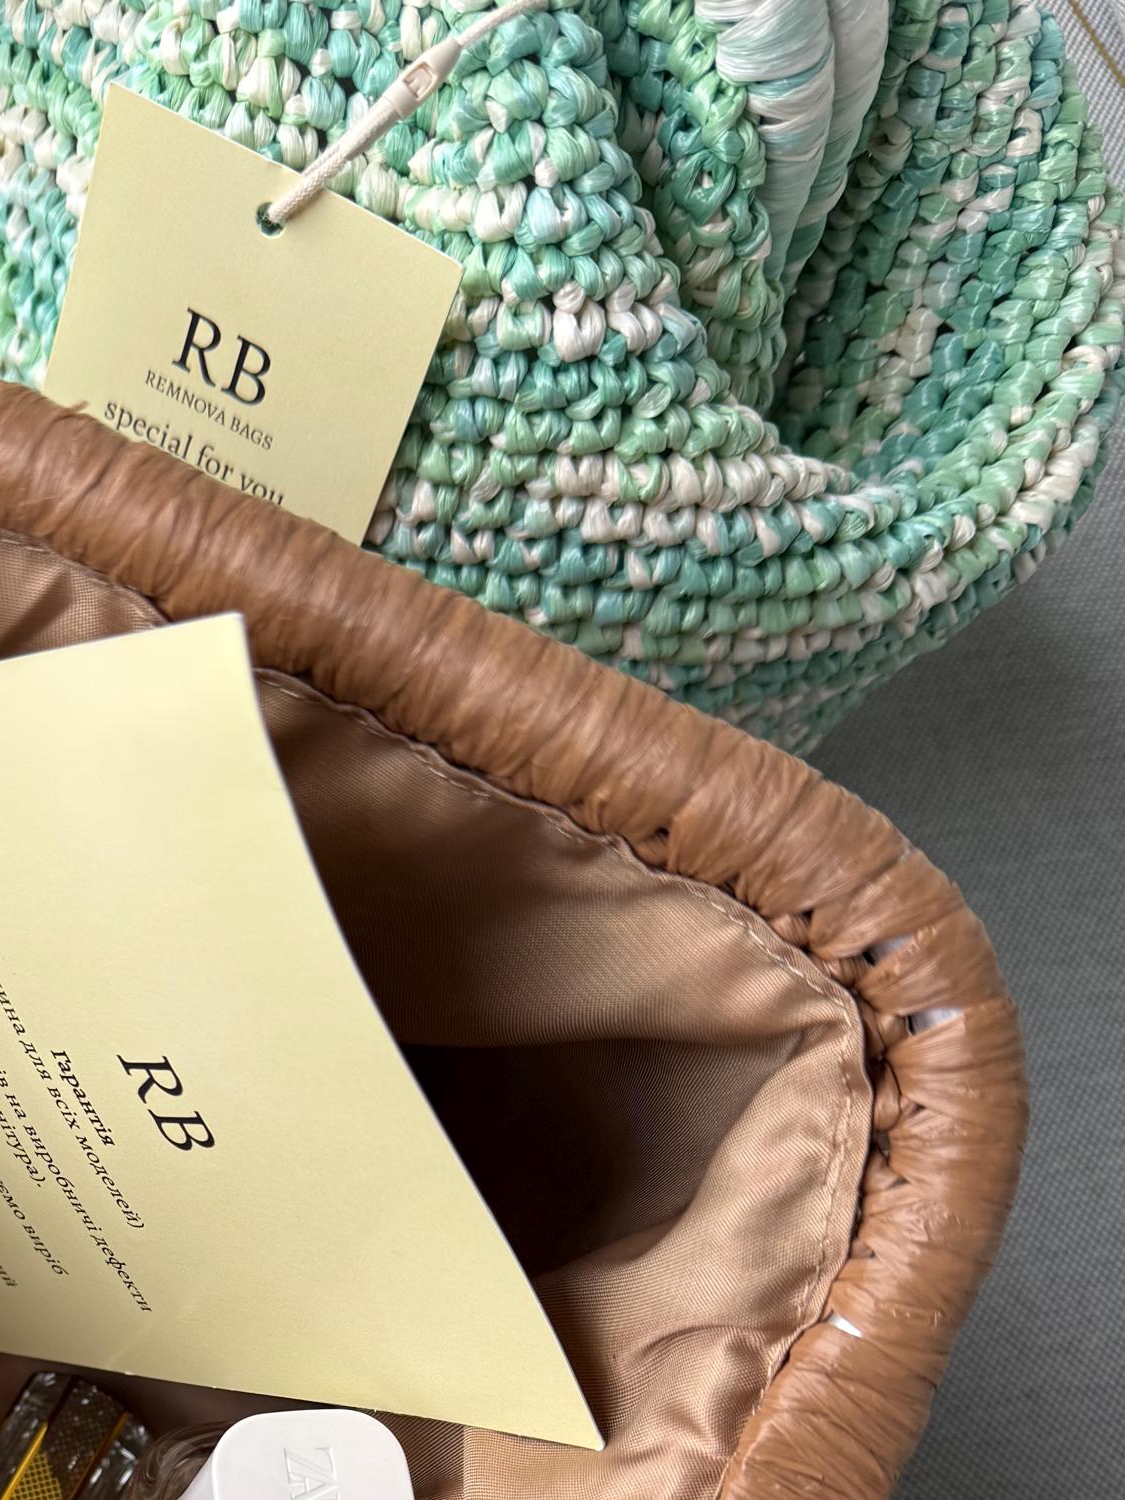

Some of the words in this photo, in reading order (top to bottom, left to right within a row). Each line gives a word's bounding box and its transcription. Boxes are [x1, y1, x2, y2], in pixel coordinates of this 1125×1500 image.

[171, 307, 271, 406] RB
[104, 401, 193, 459] special
[196, 444, 234, 481] for
[145, 369, 226, 425] REMNOVA
[230, 416, 273, 450] BAGS
[18, 1040, 53, 1081] для
[47, 1086, 81, 1130] всіх
[75, 1135, 145, 1228] моделей)
[50, 1049, 116, 1147] Гарантія
[116, 1055, 215, 1151] RB
[5, 1093, 27, 1120] на
[23, 1125, 102, 1232] виробничі
[90, 1233, 153, 1313] дефекти
[23, 1223, 69, 1276] виріб
